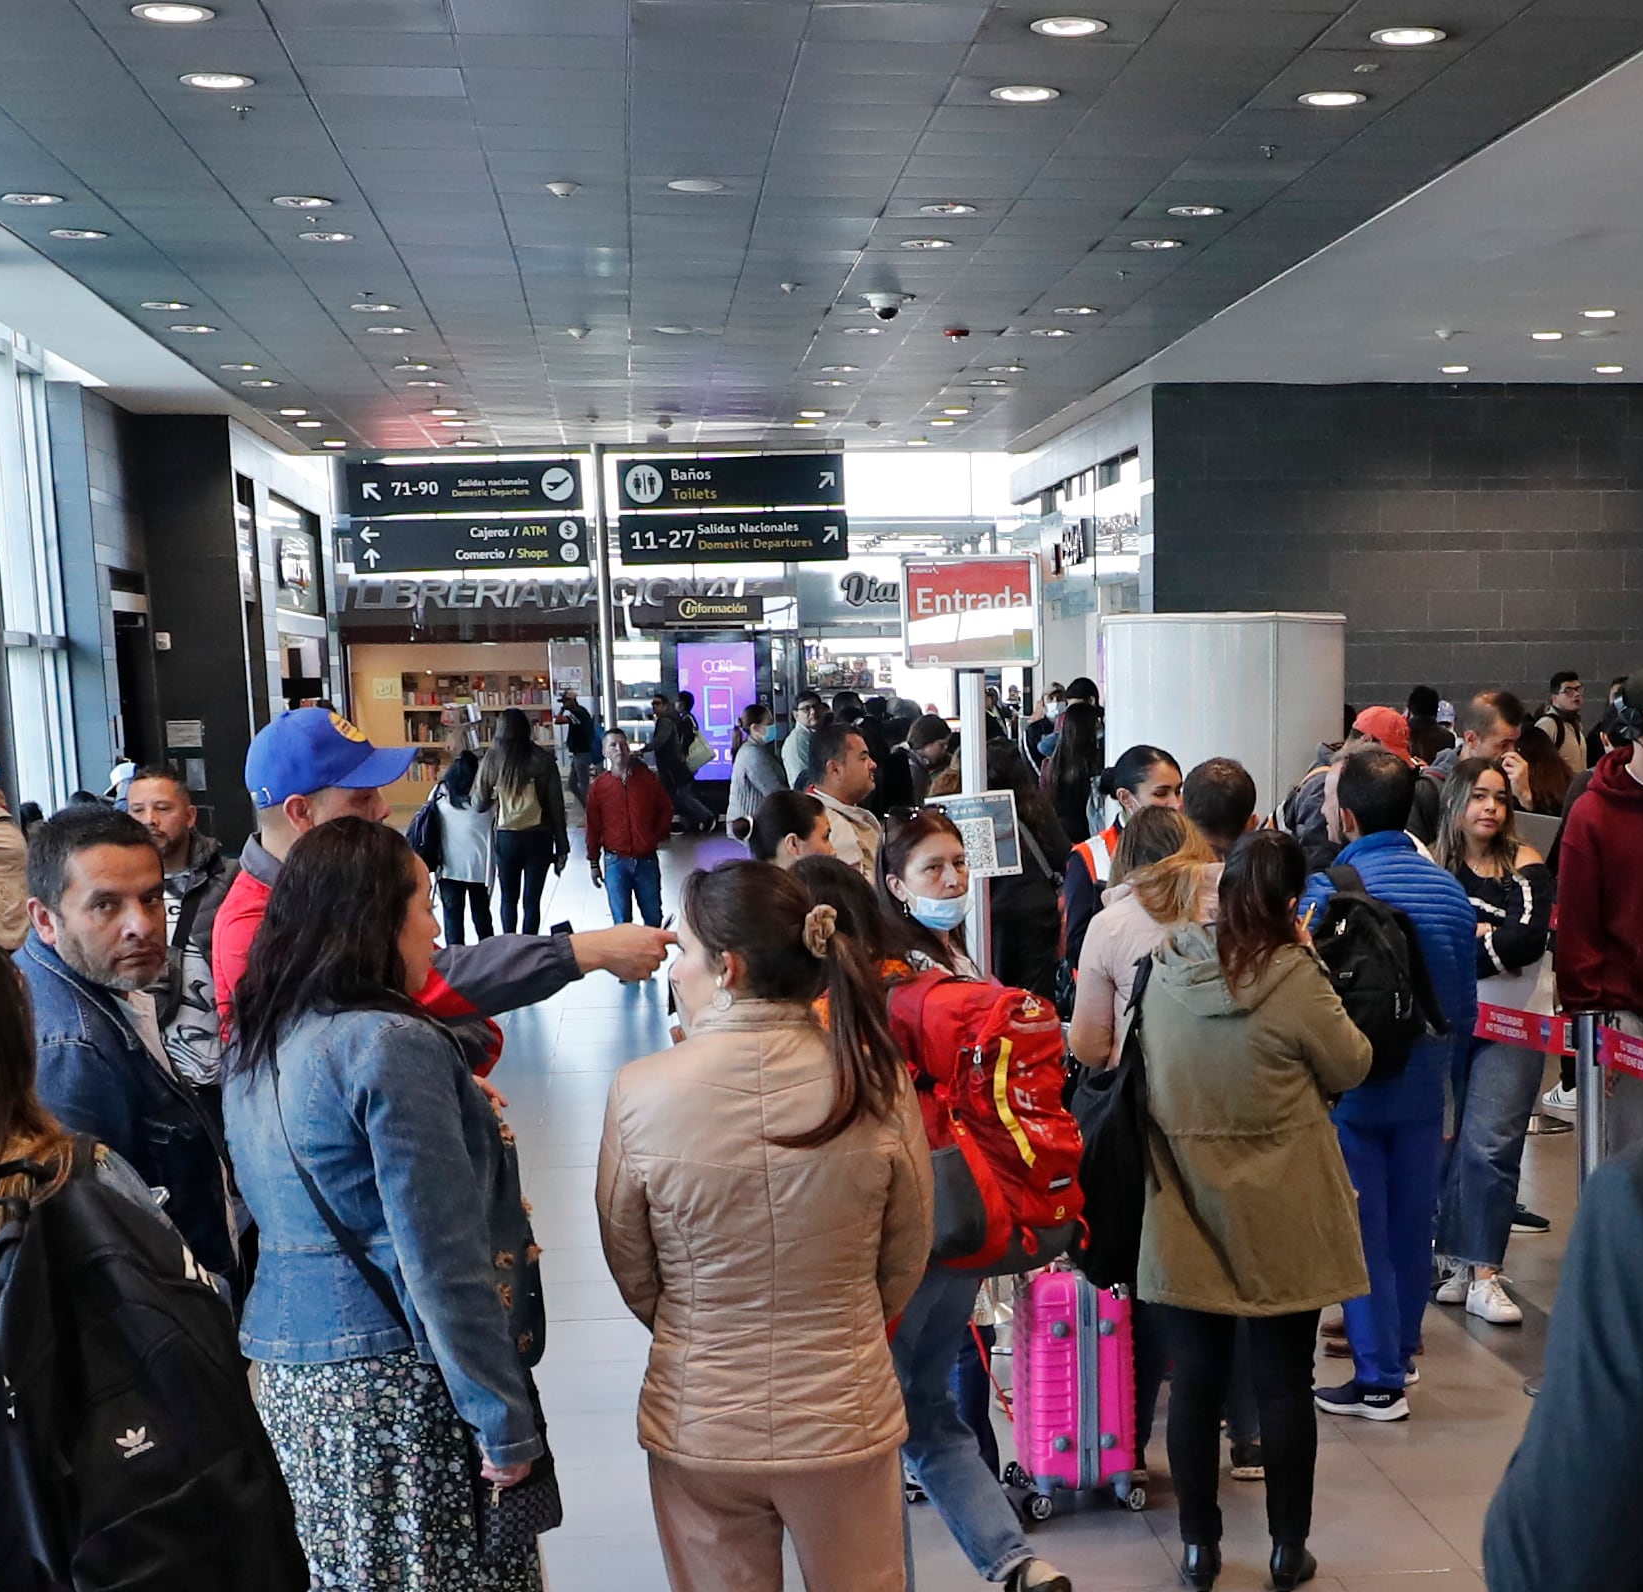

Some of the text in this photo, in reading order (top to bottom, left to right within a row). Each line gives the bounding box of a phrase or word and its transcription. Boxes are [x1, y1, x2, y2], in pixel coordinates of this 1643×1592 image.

[671, 468, 712, 481] Baños
[390, 481, 439, 497] 71-90
[457, 478, 486, 487] Salidas
[451, 487, 530, 498] Domestic Departure
[671, 488, 717, 500] Toilets
[470, 526, 510, 539] Cajeros
[522, 525, 547, 536] ATM
[630, 522, 799, 550] 11-27 Salidas Nacionales
[698, 537, 813, 550] Domestic Departures
[455, 549, 506, 560] Comercio
[516, 548, 549, 560] Shops
[355, 578, 545, 608] LIBRERIA
[917, 585, 1028, 614] Entrada
